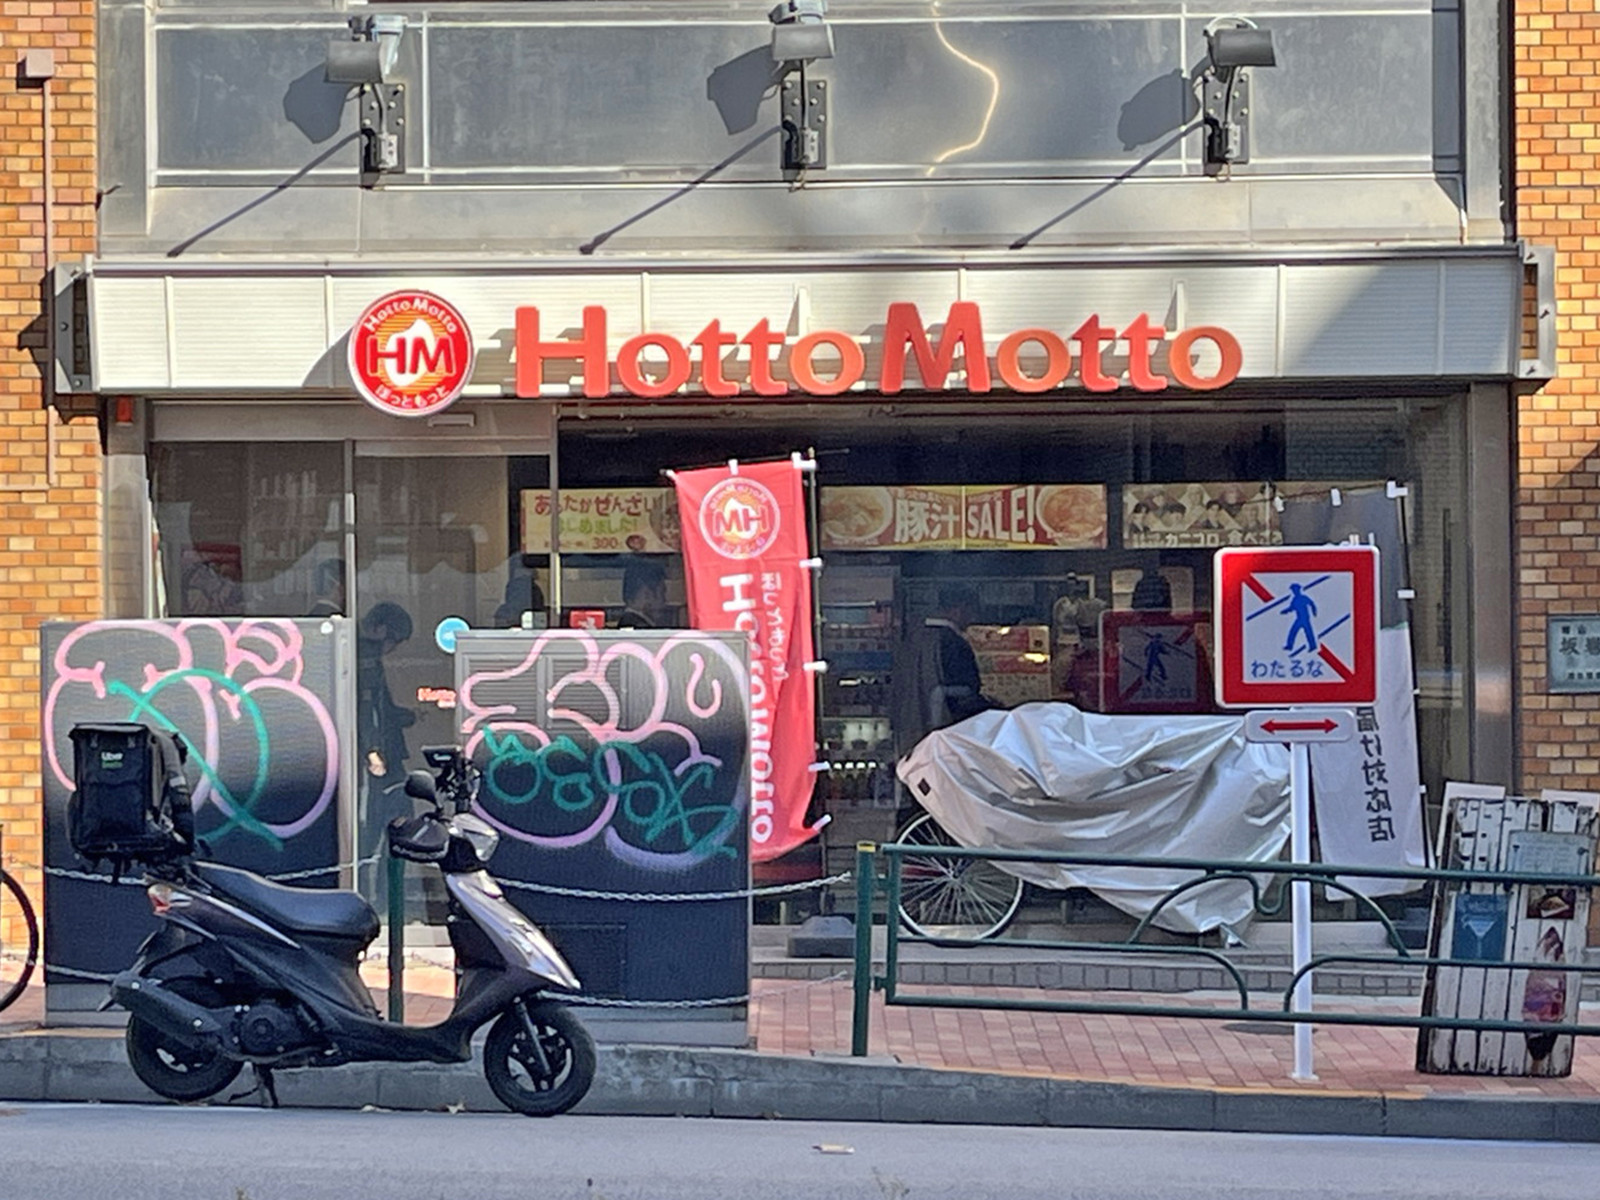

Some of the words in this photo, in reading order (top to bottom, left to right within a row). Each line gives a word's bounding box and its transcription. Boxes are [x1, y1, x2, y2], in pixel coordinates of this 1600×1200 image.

[363, 299, 411, 332] Hotto
[412, 297, 458, 333] Motto
[366, 335, 457, 377] HM
[515, 305, 865, 398] Hotto
[881, 301, 1243, 393] Motto
[375, 384, 451, 409] ほっともっと
[967, 485, 1036, 544] SALE!
[1251, 660, 1324, 679] わたるな
